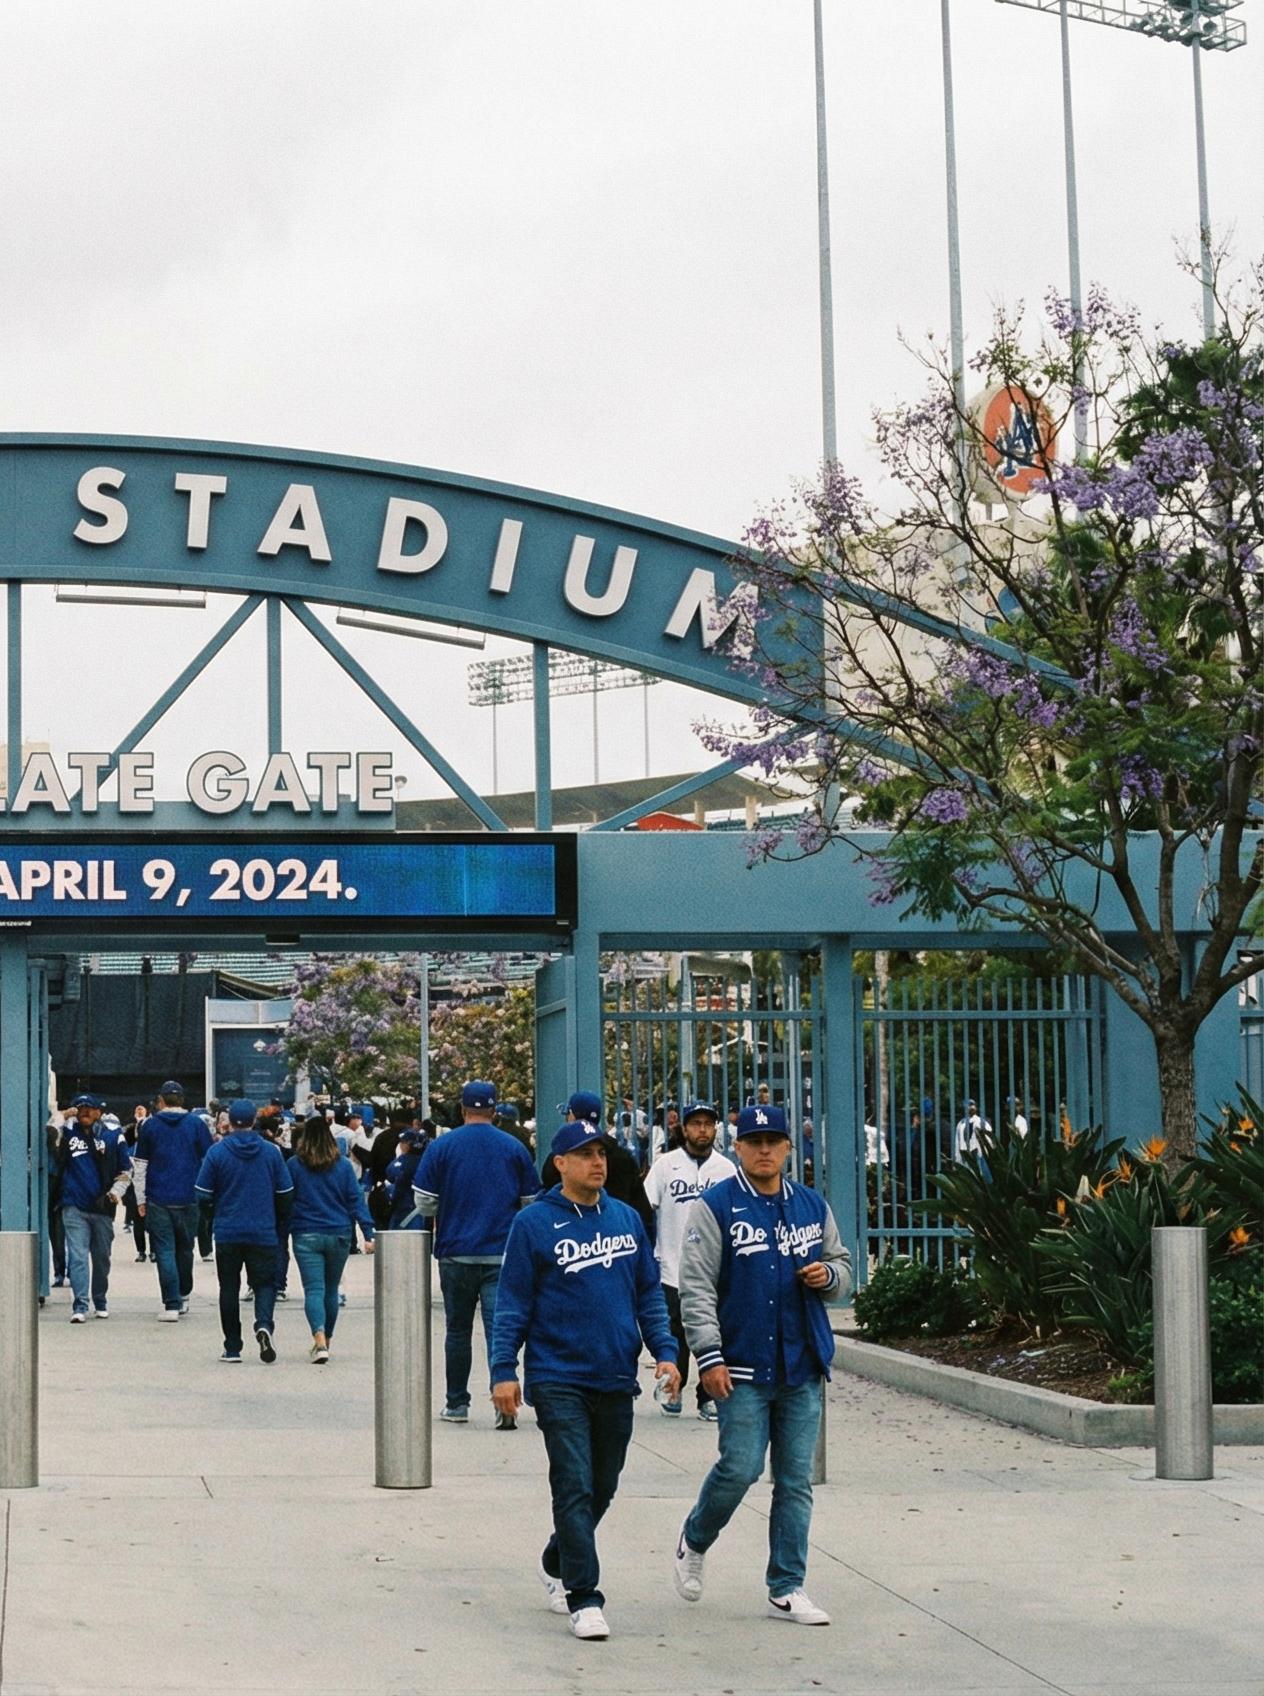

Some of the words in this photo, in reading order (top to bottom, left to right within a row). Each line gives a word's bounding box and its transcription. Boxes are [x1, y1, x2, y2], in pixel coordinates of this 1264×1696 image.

[72, 466, 759, 660] STADIUM
[185, 750, 394, 815] GATE
[141, 859, 192, 907] 9,
[208, 859, 358, 901] 2024.
[754, 1109, 769, 1125] LA
[554, 1232, 637, 1274] Dodgers
